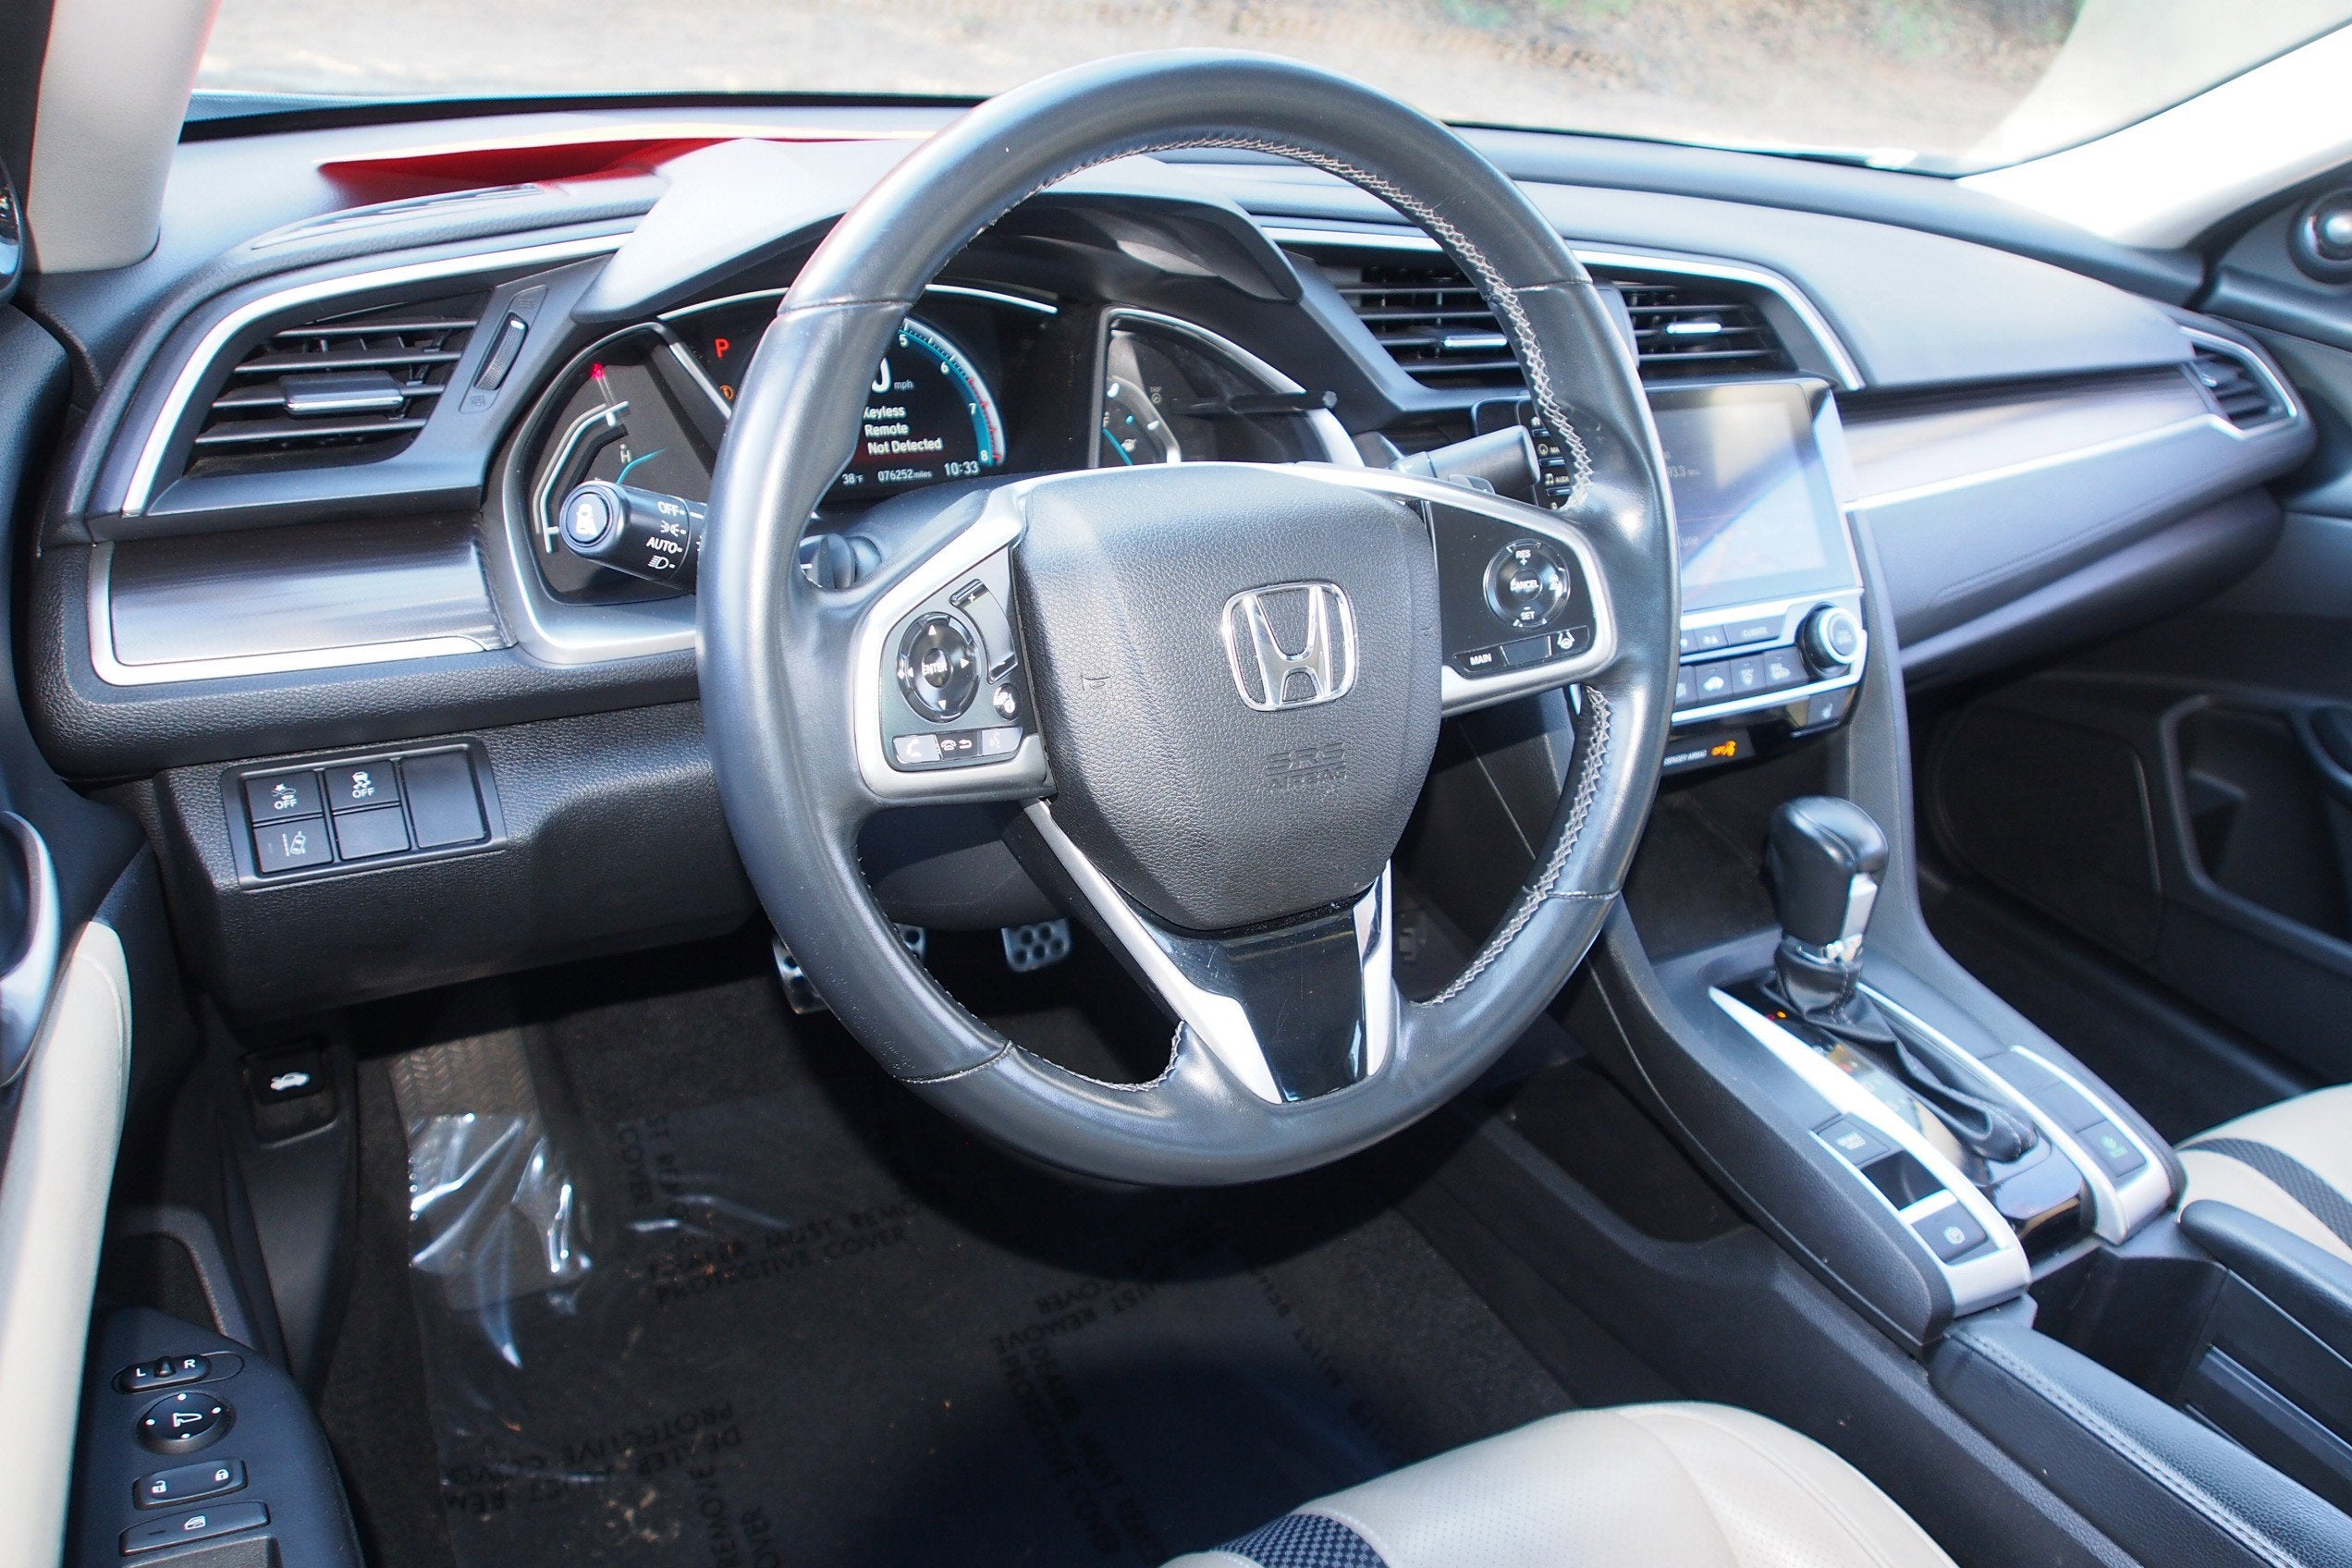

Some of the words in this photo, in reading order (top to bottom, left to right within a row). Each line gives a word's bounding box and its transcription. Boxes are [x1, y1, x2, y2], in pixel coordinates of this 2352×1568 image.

[900, 334, 909, 348] 5
[715, 338, 730, 359] P
[940, 361, 949, 375] 6
[894, 380, 914, 391] mph
[969, 402, 977, 415] 7
[864, 423, 910, 437] Remote
[867, 441, 890, 456] Not
[891, 437, 943, 454] Detected
[980, 449, 989, 462] 8
[944, 461, 980, 476] 10:33
[657, 501, 680, 516] OFF
[646, 536, 679, 555] AUTO
[1515, 549, 1531, 559] RES
[1521, 610, 1536, 620] SET
[1469, 653, 1492, 666] MAIN
[922, 660, 949, 676] ENTER
[352, 787, 374, 799] OFF
[274, 798, 297, 810] OFF
[136, 1366, 146, 1377] L
[184, 1358, 196, 1369] R
